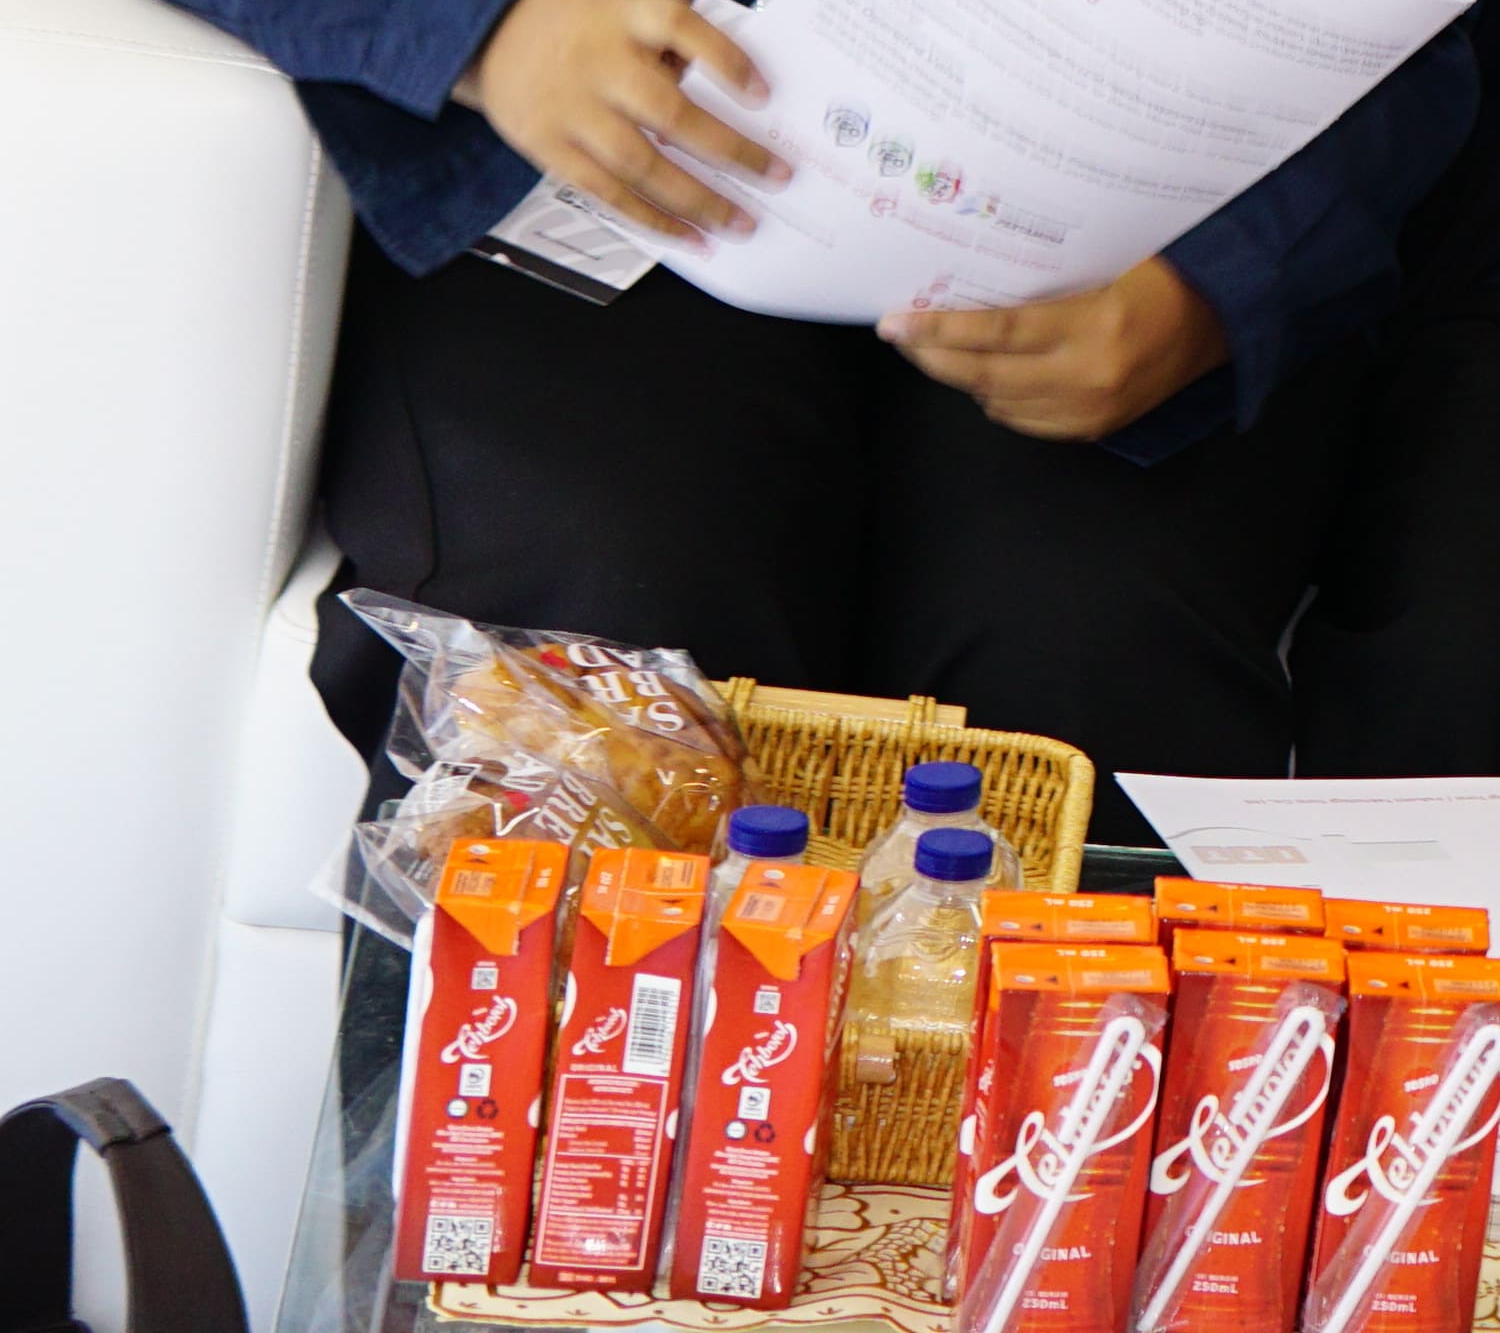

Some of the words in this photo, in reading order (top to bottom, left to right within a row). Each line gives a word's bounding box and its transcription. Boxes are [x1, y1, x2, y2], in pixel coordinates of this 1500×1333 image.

[1186, 1228, 1262, 1247] OGINAL
[1013, 1243, 1092, 1262] OGINAL
[1363, 1246, 1439, 1265] OGINAL
